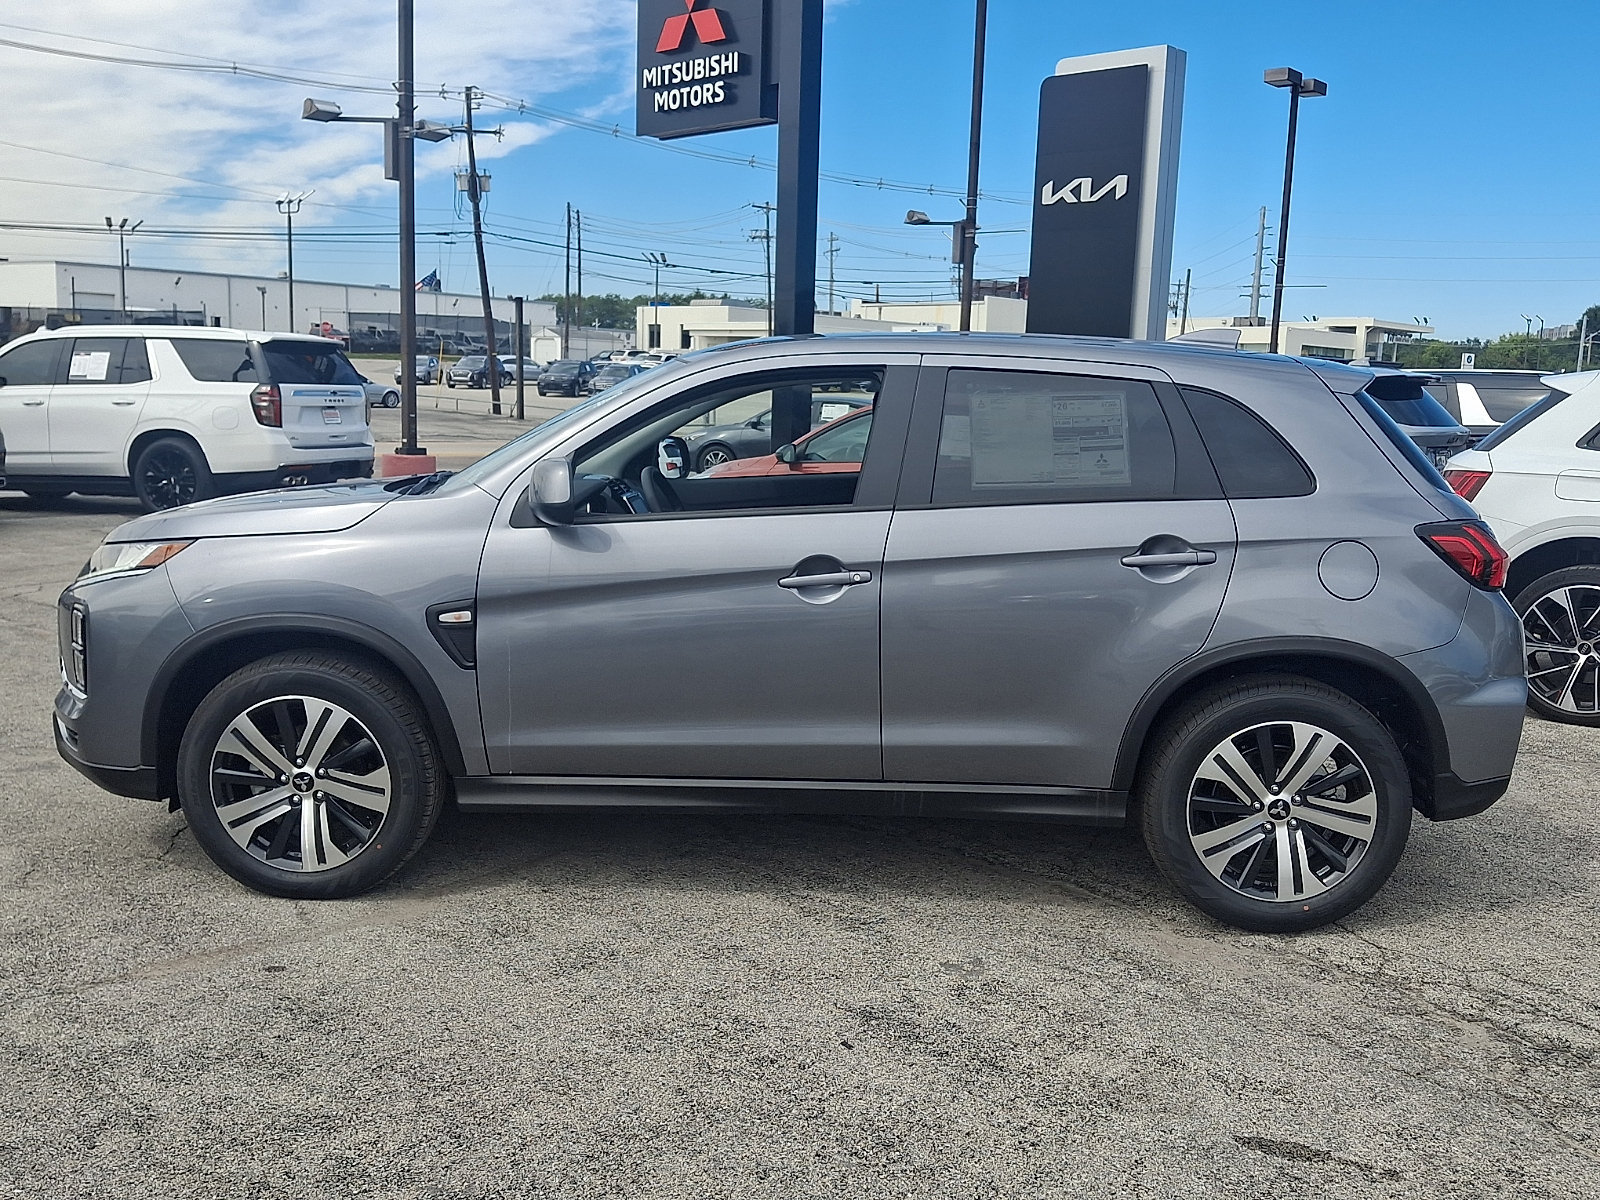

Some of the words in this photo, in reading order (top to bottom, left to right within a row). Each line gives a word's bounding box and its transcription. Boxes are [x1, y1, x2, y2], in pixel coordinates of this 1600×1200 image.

[642, 51, 739, 89] MITSUBISHI
[653, 80, 725, 113] MOTORS
[1041, 174, 1128, 205] KIA
